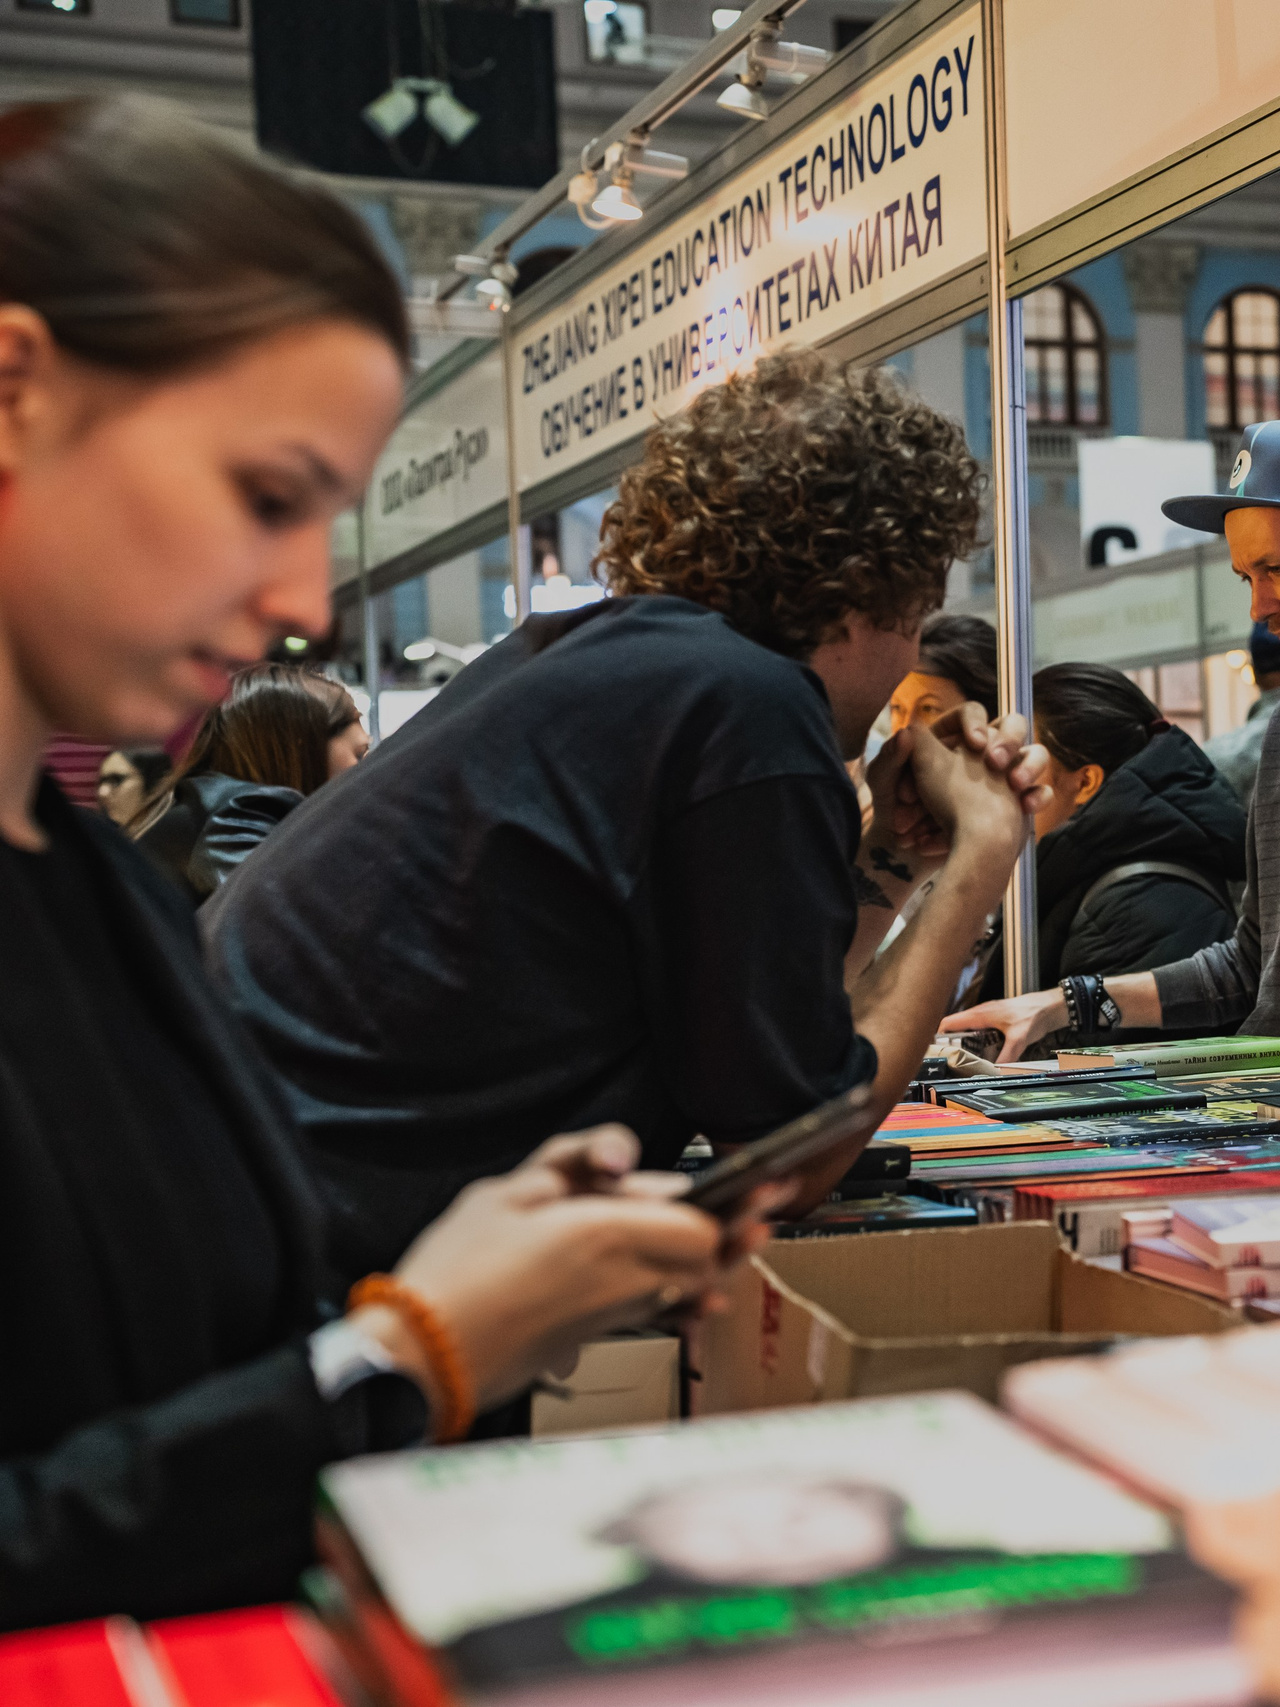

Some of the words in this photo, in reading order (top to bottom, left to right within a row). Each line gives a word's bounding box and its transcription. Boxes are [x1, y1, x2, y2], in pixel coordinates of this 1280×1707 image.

[522, 313, 598, 395] ZHEJIANG
[600, 257, 649, 343] XIPEI
[651, 182, 773, 314] EDUCATION
[778, 34, 976, 231] TECHNOLOGY
[540, 364, 629, 458] ОБУЧЕНИЕ
[633, 357, 645, 411] В
[648, 237, 842, 402] УНИВЕРСИТЕТАХ
[848, 174, 944, 296] КИТАЯ
[1184, 1056, 1207, 1065] ТАЙНЫ
[1209, 1052, 1258, 1063] СОВРЕМЕННЫХ
